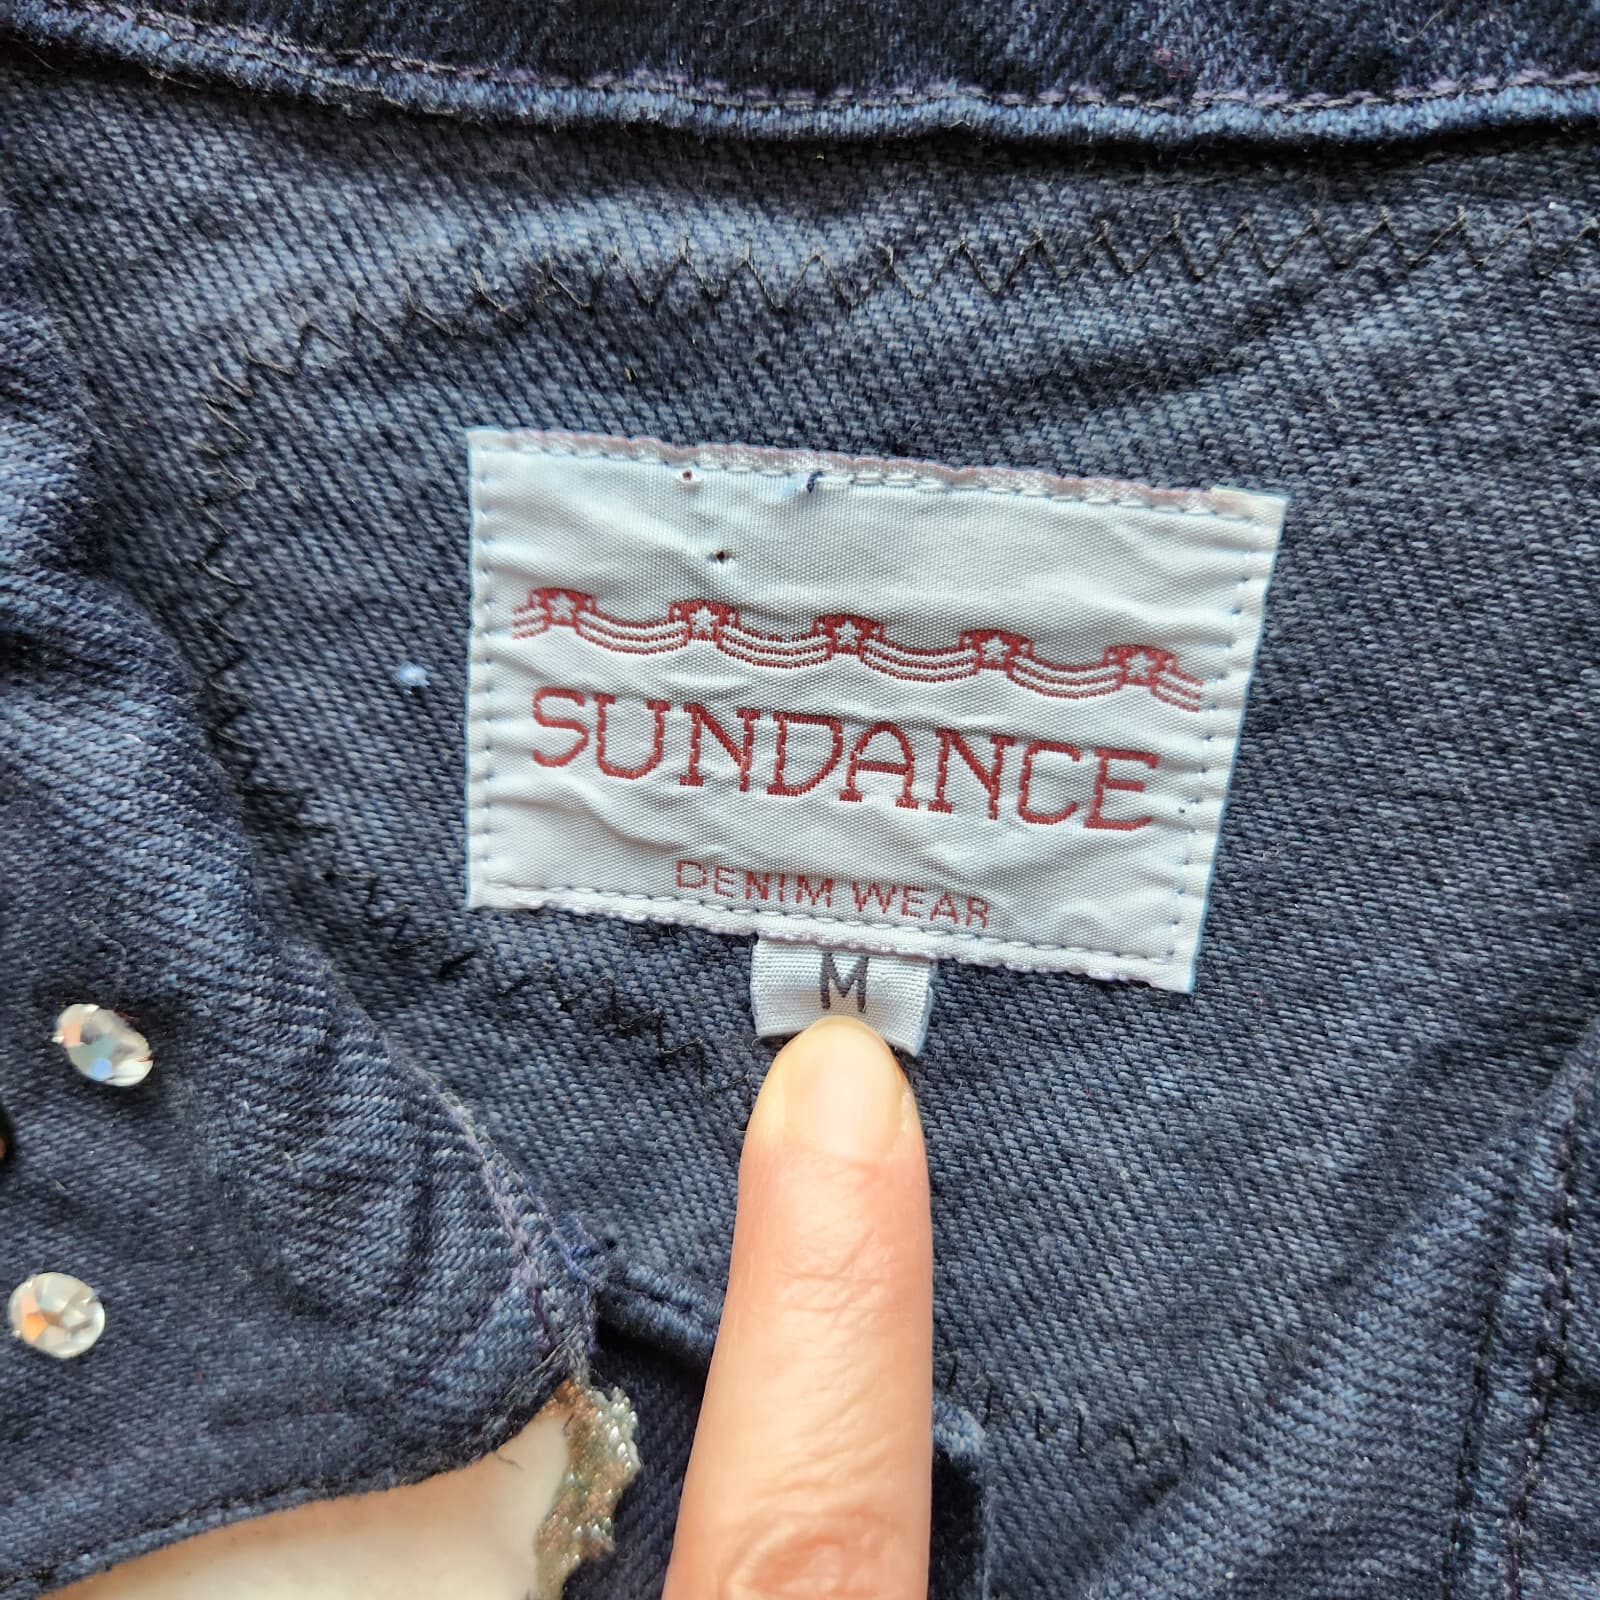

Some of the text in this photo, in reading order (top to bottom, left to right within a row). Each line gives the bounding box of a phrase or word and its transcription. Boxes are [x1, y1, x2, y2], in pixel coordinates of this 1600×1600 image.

[532, 686, 1159, 831] SUNDANCE
[675, 859, 990, 928] DENIM WEAR
[819, 952, 869, 1013] M
